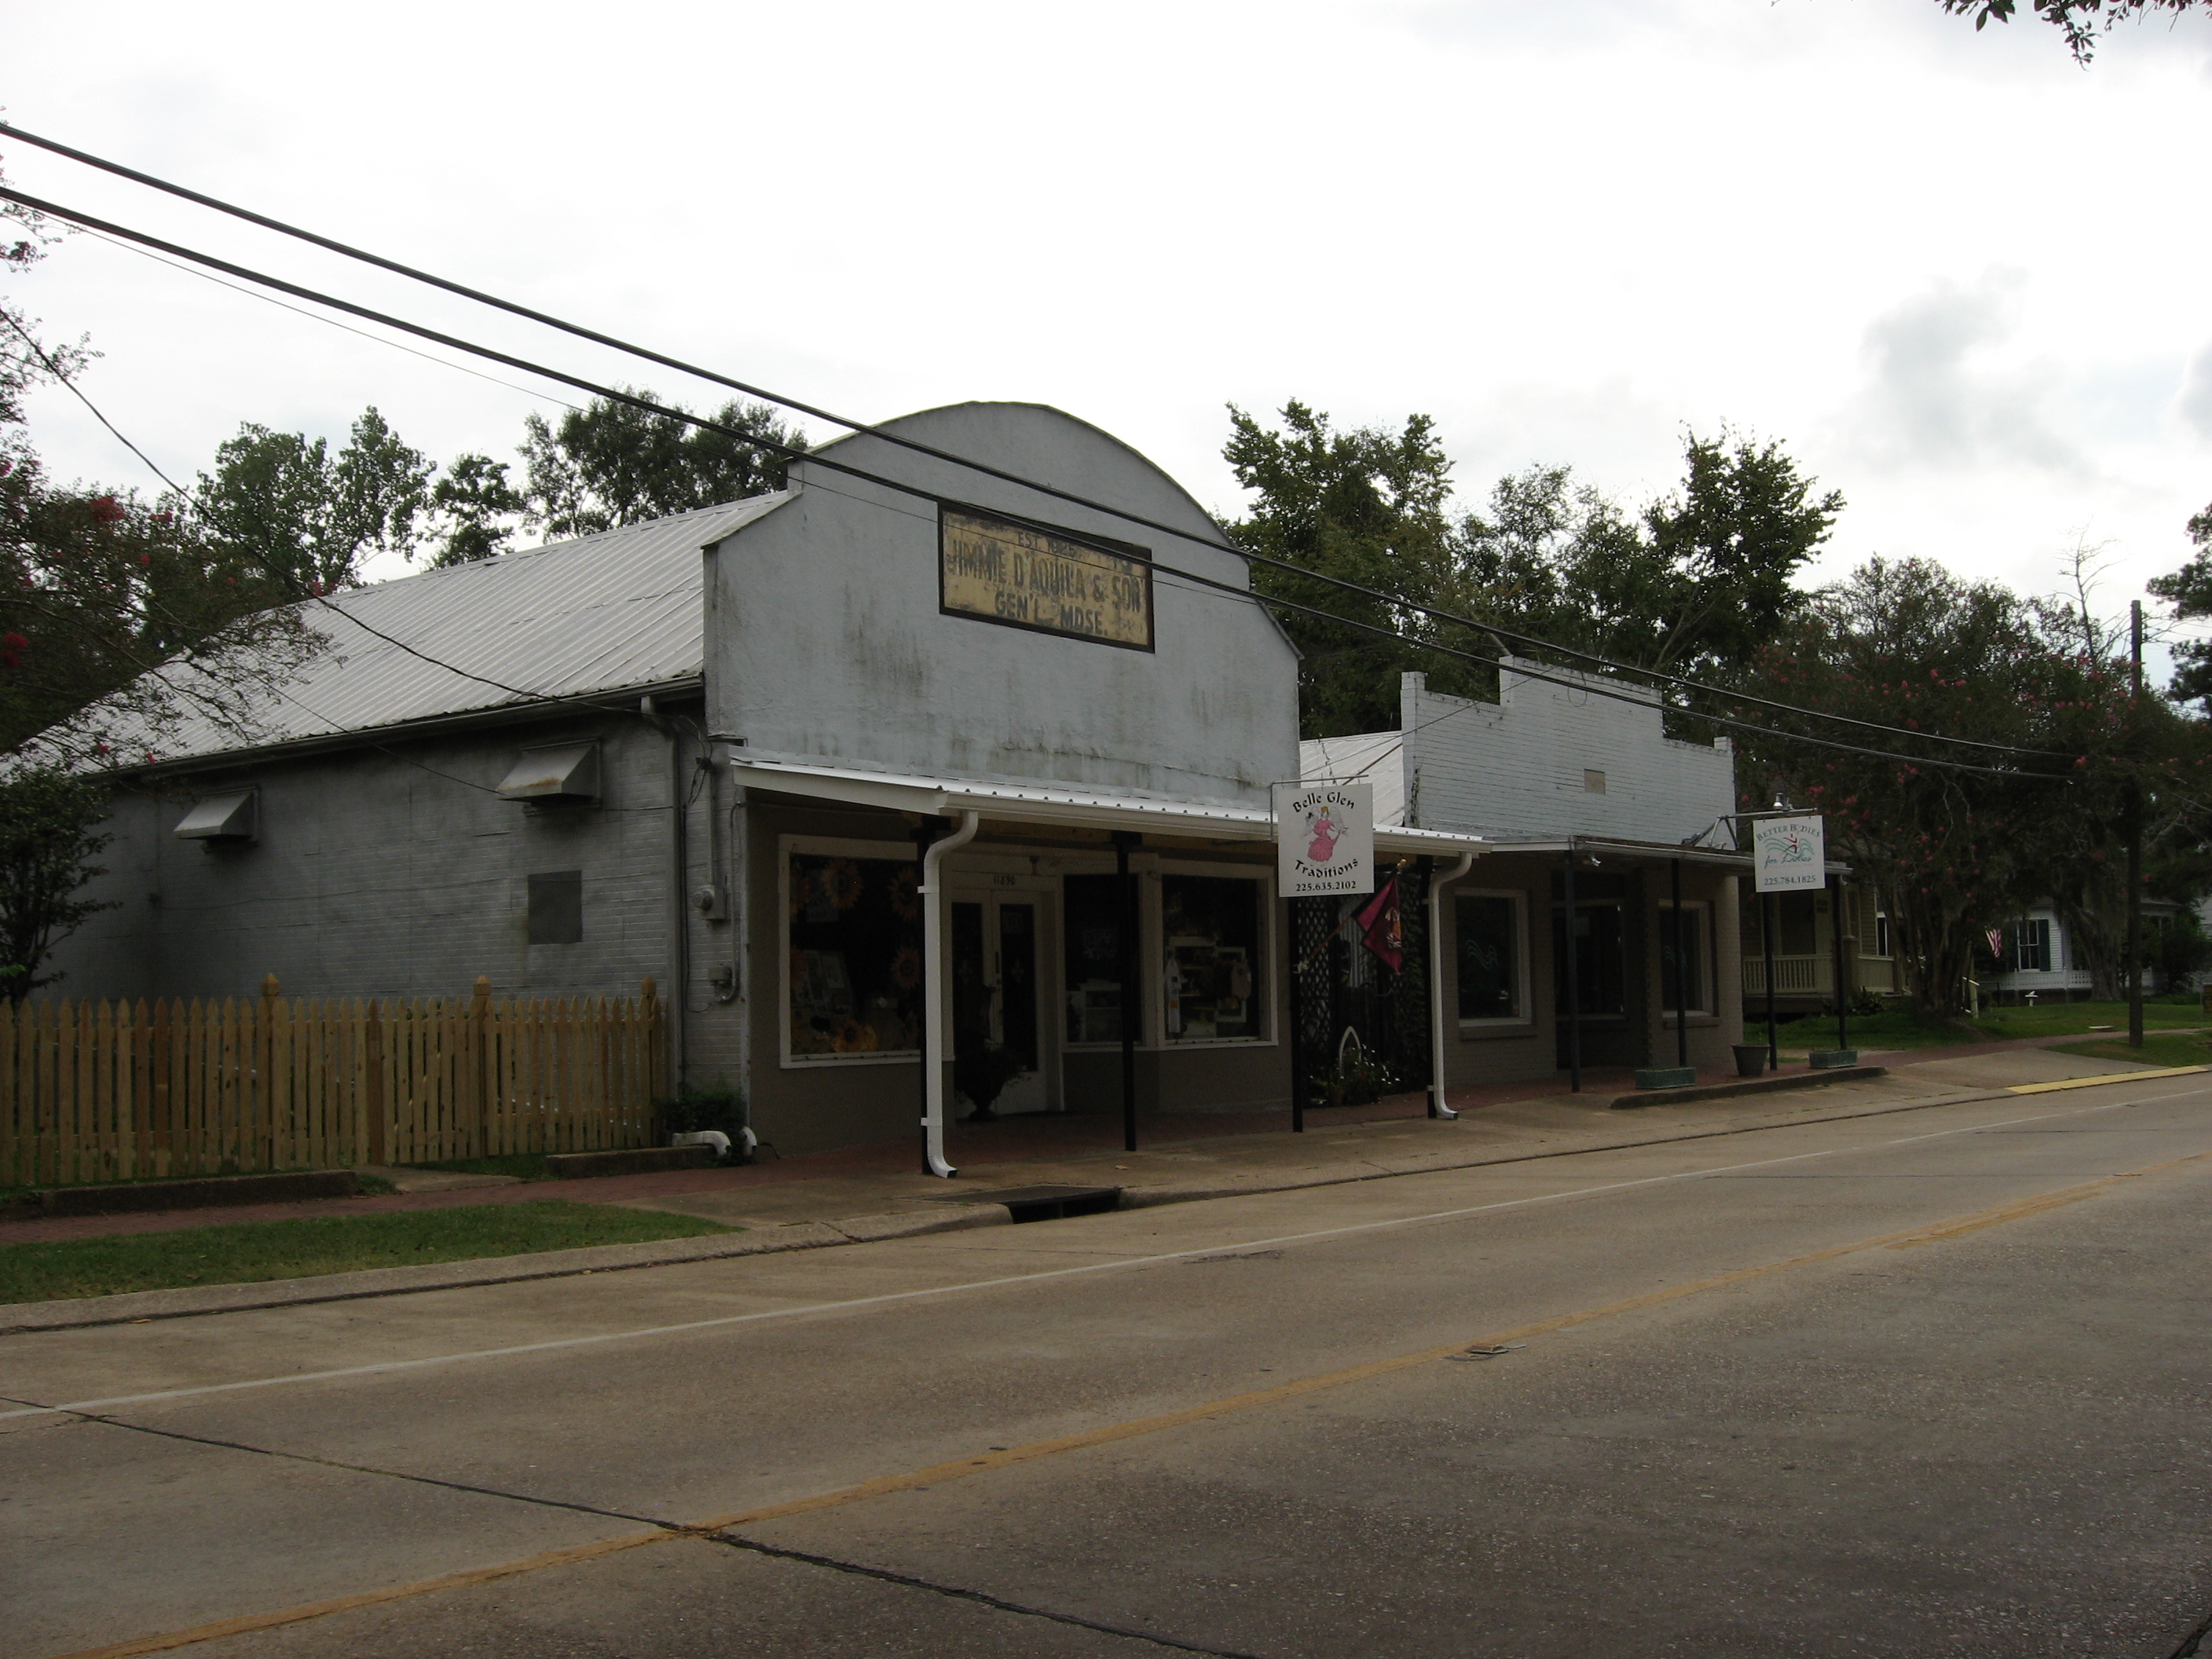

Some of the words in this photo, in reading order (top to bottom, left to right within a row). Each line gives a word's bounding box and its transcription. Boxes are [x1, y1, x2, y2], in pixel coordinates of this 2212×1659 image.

[1292, 793, 1322, 813] Belle
[1327, 791, 1355, 809] Glen
[1756, 826, 1788, 841] BETTER
[1294, 858, 1359, 878] Traditions
[1296, 880, 1357, 892] 225.635.2102
[1764, 875, 1816, 885] 225.784.1825
